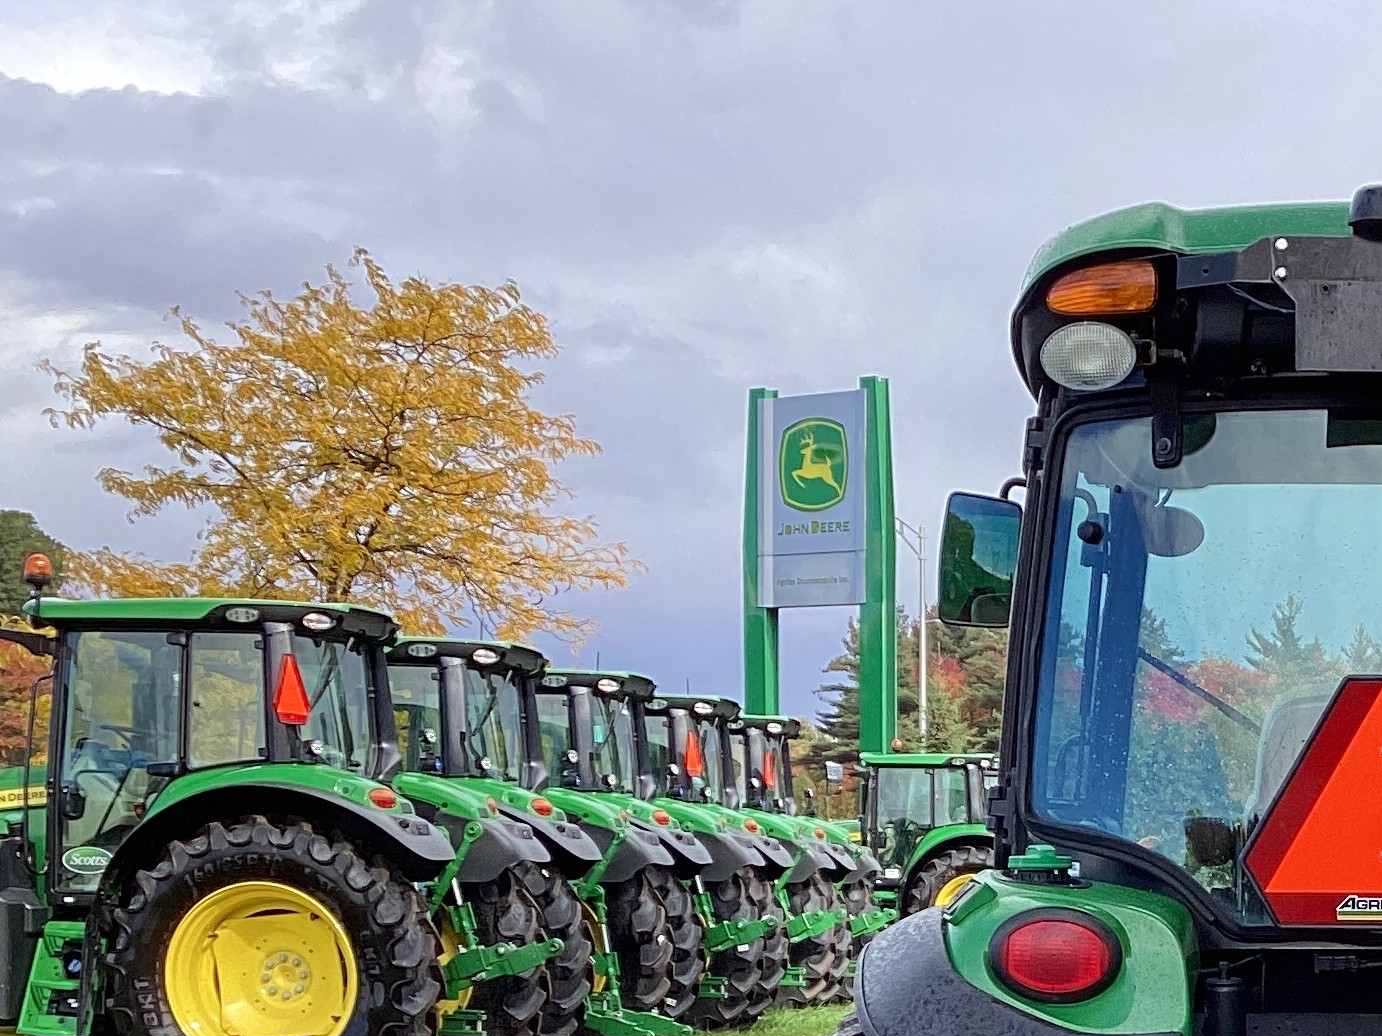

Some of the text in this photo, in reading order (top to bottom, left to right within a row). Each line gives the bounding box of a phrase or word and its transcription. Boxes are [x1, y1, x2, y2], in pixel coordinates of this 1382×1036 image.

[777, 521, 850, 536] JOHN DEERE
[8, 791, 46, 801] DERE
[70, 854, 107, 865] Scotts
[134, 979, 158, 1026] BKT
